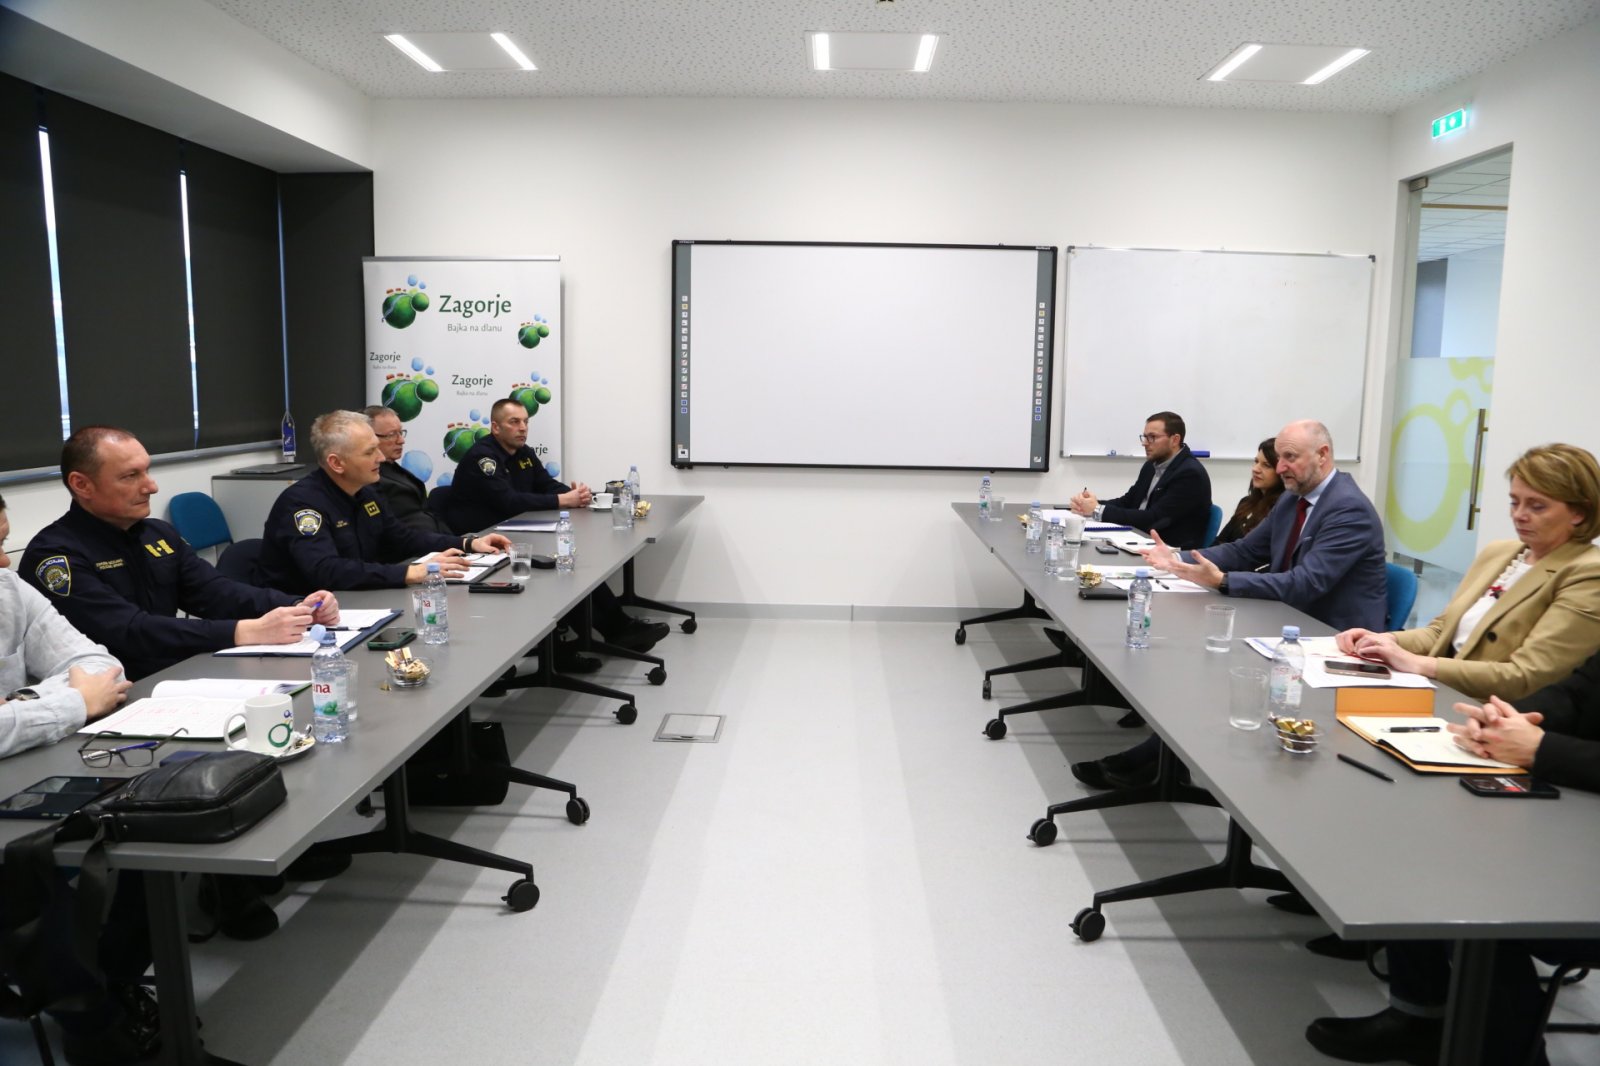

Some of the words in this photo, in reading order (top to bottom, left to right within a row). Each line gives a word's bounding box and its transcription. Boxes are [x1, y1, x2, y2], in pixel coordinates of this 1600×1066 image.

[439, 294, 512, 318] Zagorje
[447, 323, 468, 333] Bajka
[480, 323, 503, 332] dlanu
[369, 351, 401, 363] Zagorje
[451, 374, 494, 388] Zagorje
[531, 443, 549, 456] rje
